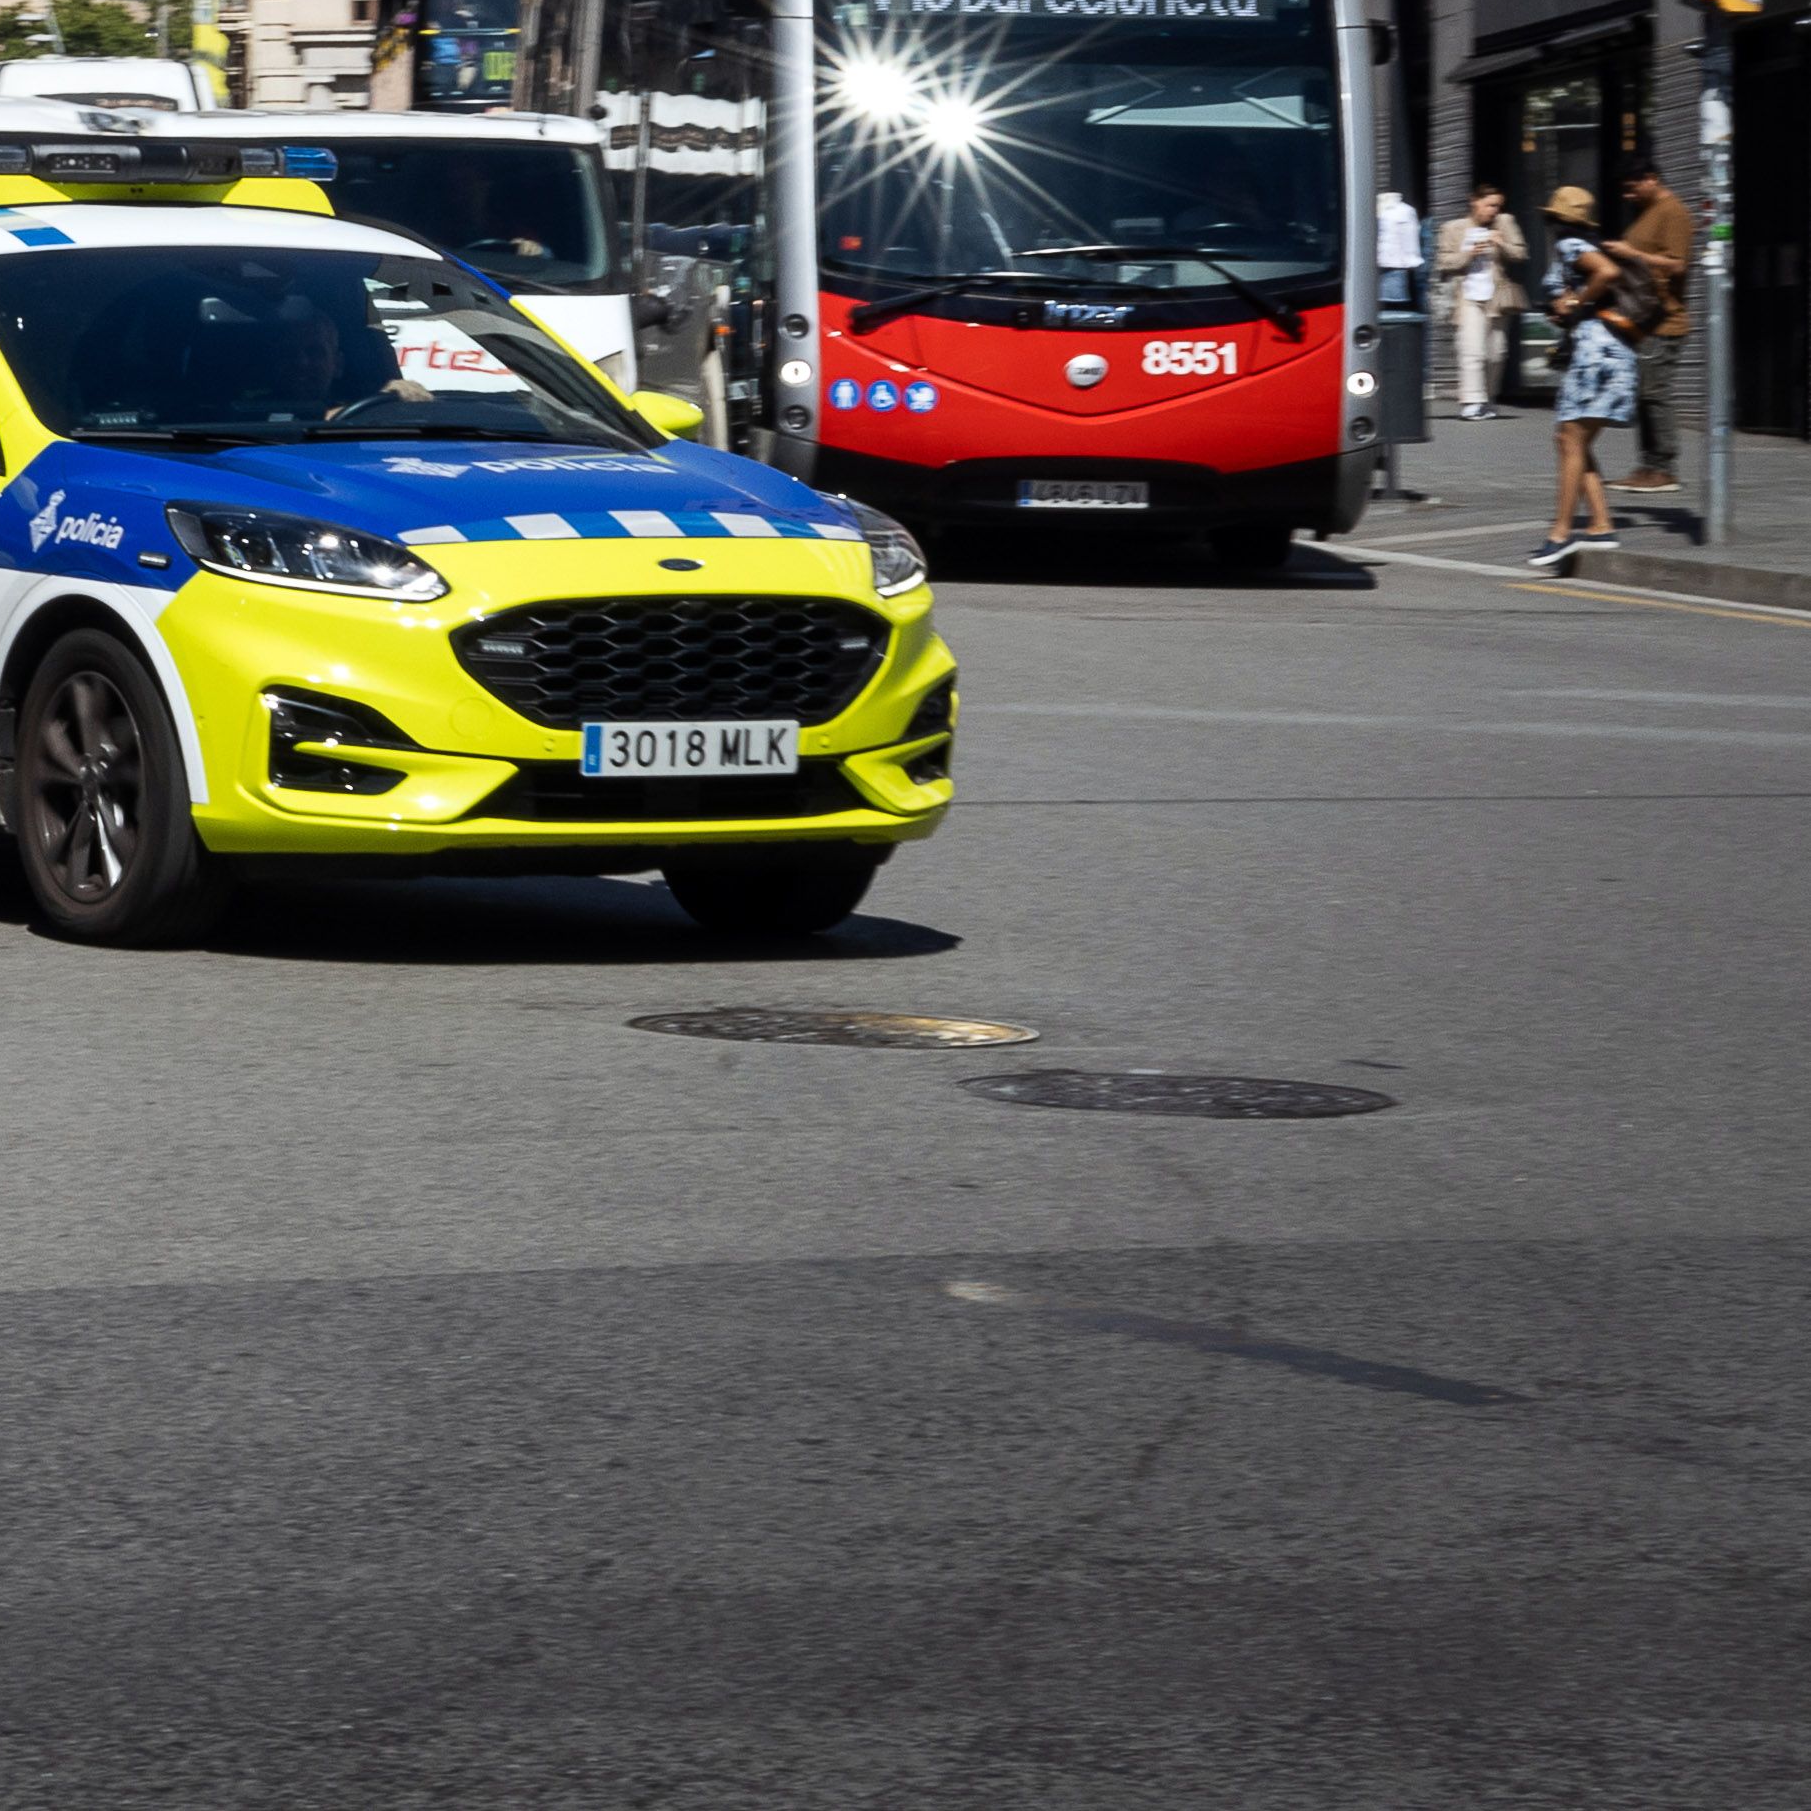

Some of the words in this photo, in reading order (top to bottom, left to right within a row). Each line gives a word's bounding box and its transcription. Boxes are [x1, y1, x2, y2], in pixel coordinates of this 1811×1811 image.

[1141, 340, 1239, 375] 8551
[54, 512, 125, 550] policia
[609, 729, 706, 767] 3018
[719, 727, 788, 766] MLK
